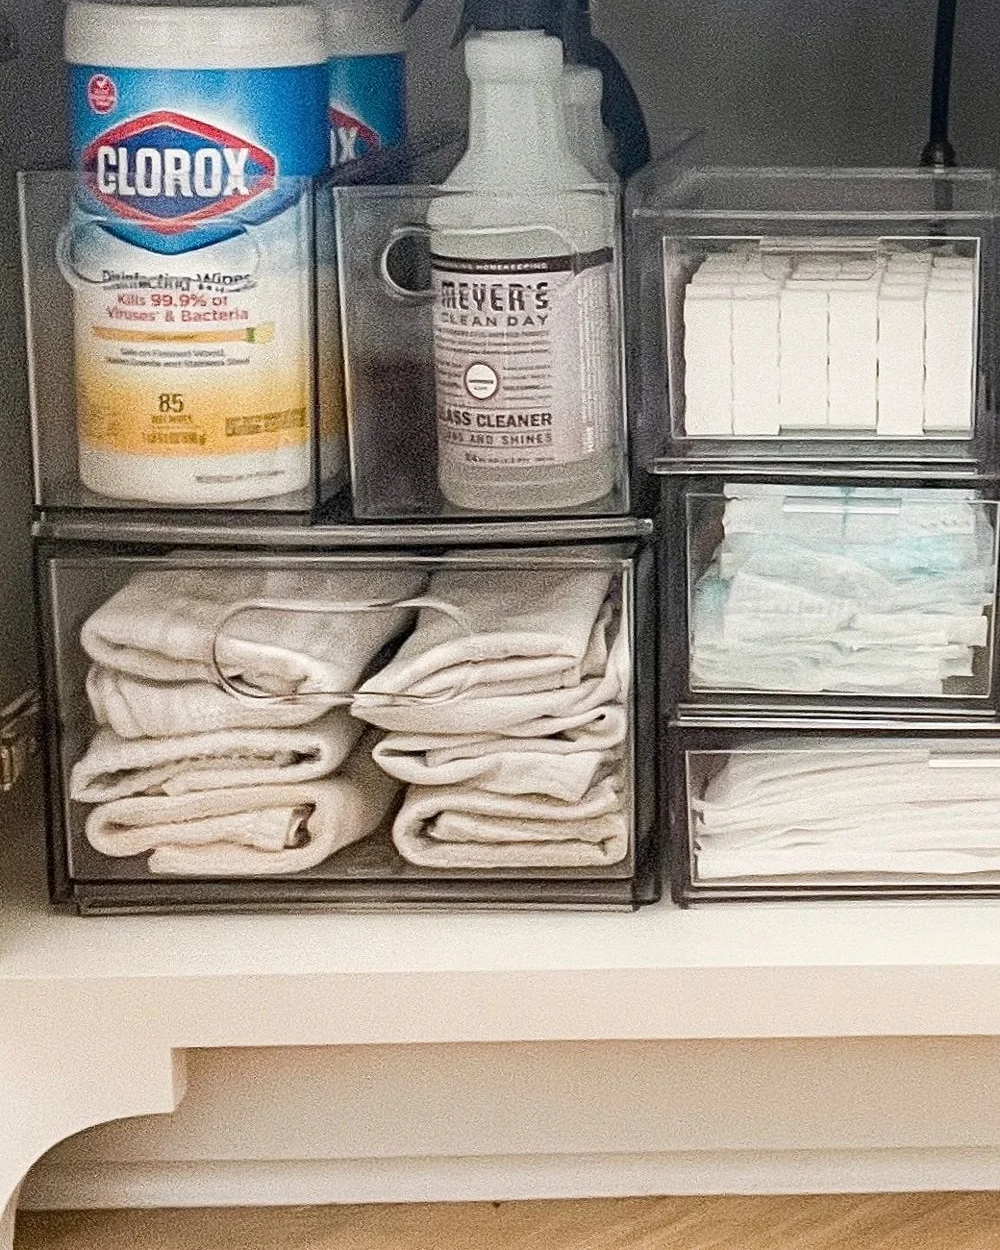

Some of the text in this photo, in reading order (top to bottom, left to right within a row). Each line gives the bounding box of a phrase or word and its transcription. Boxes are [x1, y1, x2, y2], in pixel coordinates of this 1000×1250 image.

[98, 146, 249, 197] CLOROX
[117, 292, 229, 308] Kills 99.9% of
[441, 282, 549, 311] MEYER'S
[165, 310, 176, 322] &
[180, 307, 249, 322] Bacteria
[441, 312, 549, 327] CLEAN DAY
[158, 393, 185, 413] 85
[476, 412, 552, 428] CLEANER
[470, 434, 494, 445] AND
[502, 433, 552, 445] SHINES
